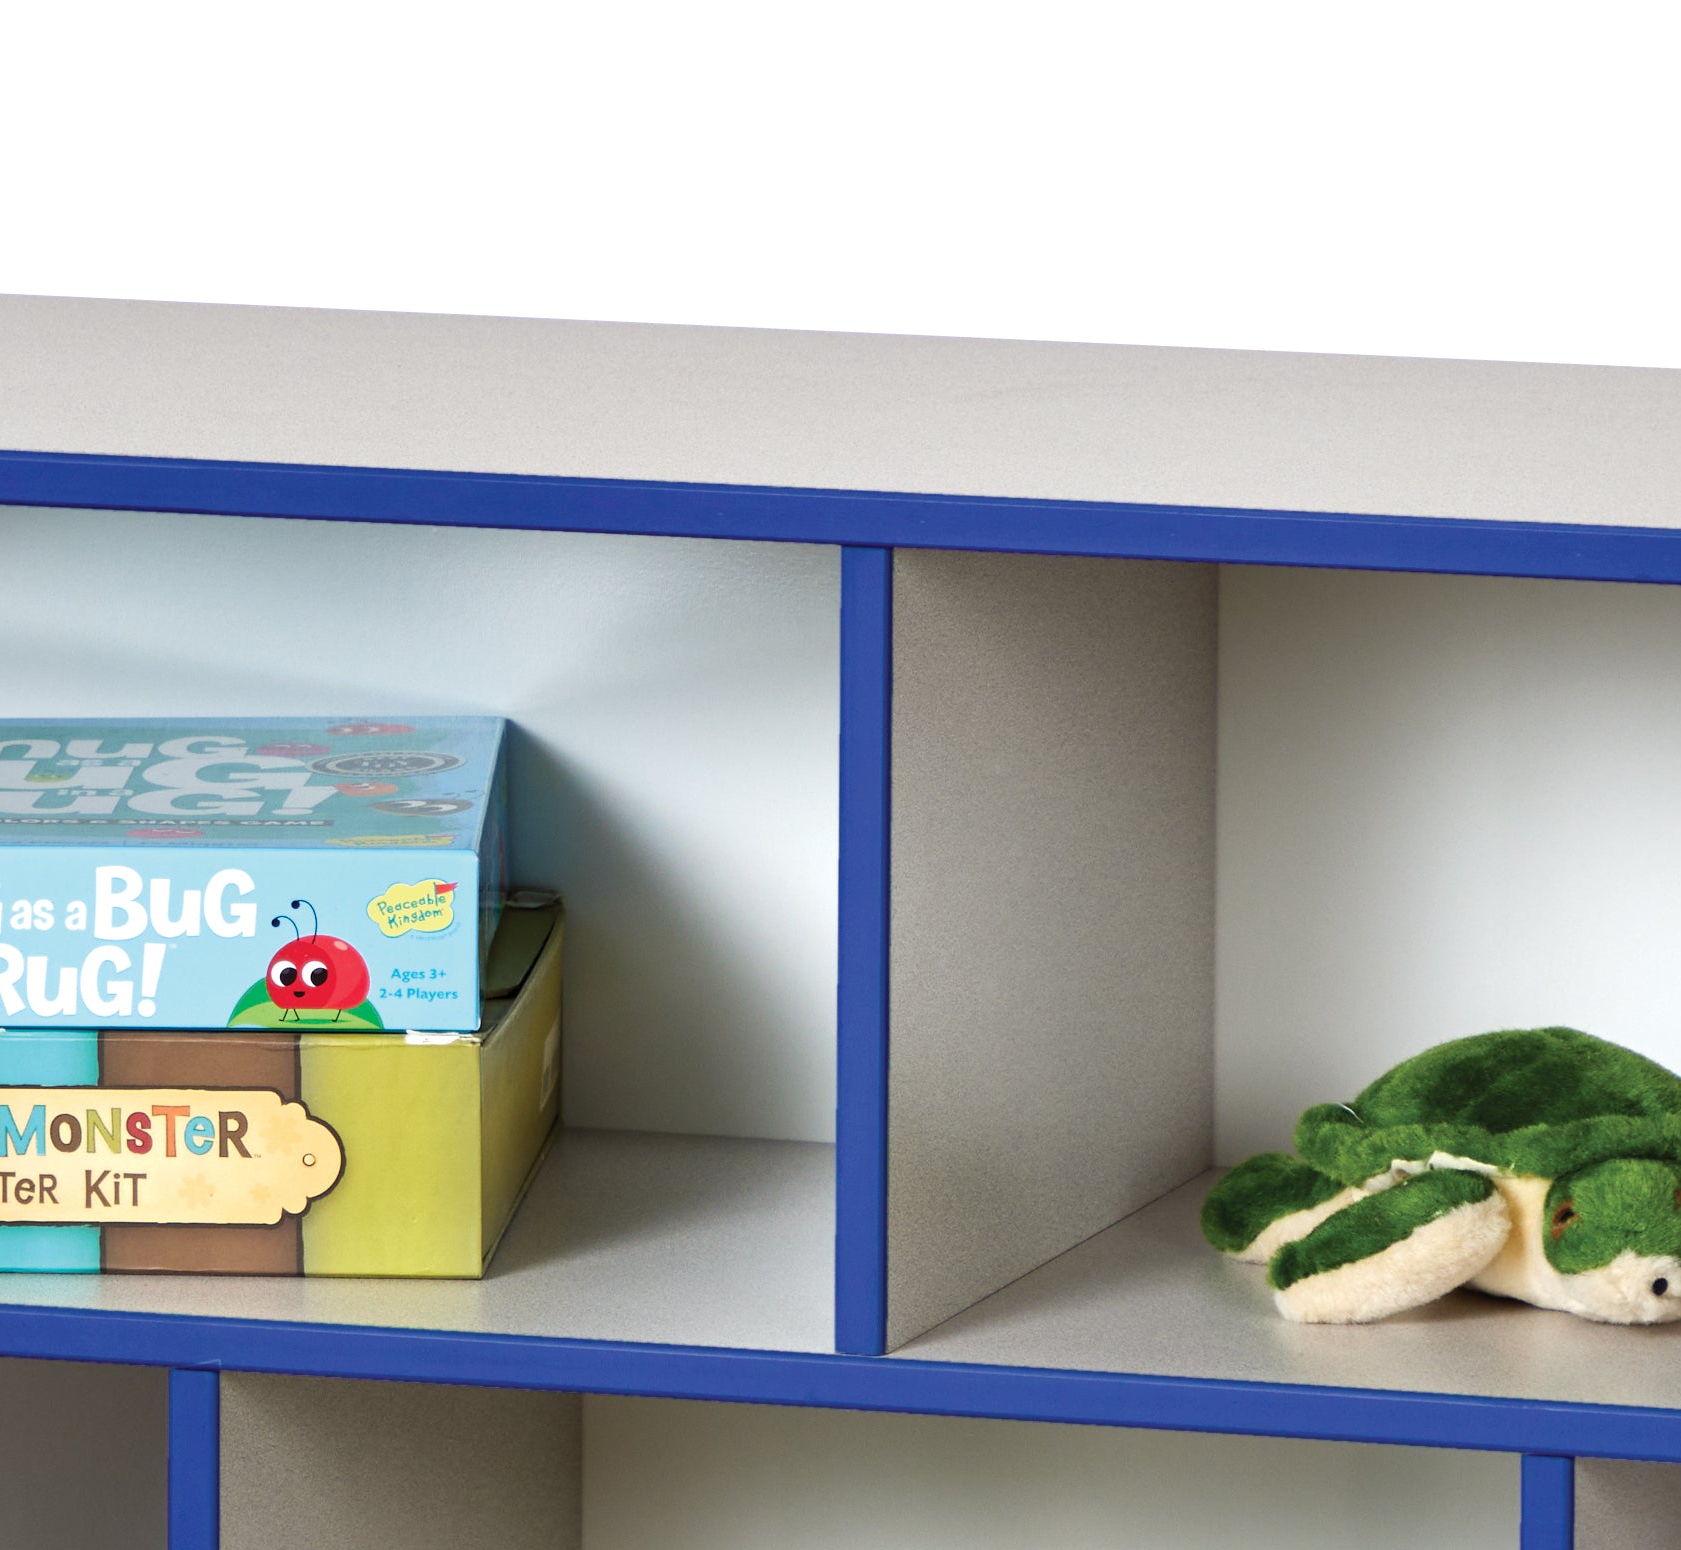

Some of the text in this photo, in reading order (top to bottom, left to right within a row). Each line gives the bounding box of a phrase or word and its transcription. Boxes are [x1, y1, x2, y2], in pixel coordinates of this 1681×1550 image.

[377, 882, 446, 915] Peaceable
[10, 898, 54, 930] as
[65, 900, 86, 931] a
[387, 908, 443, 929] Kingdom
[391, 968, 447, 983] Ages 3+
[379, 987, 458, 1002] 2-4 Players
